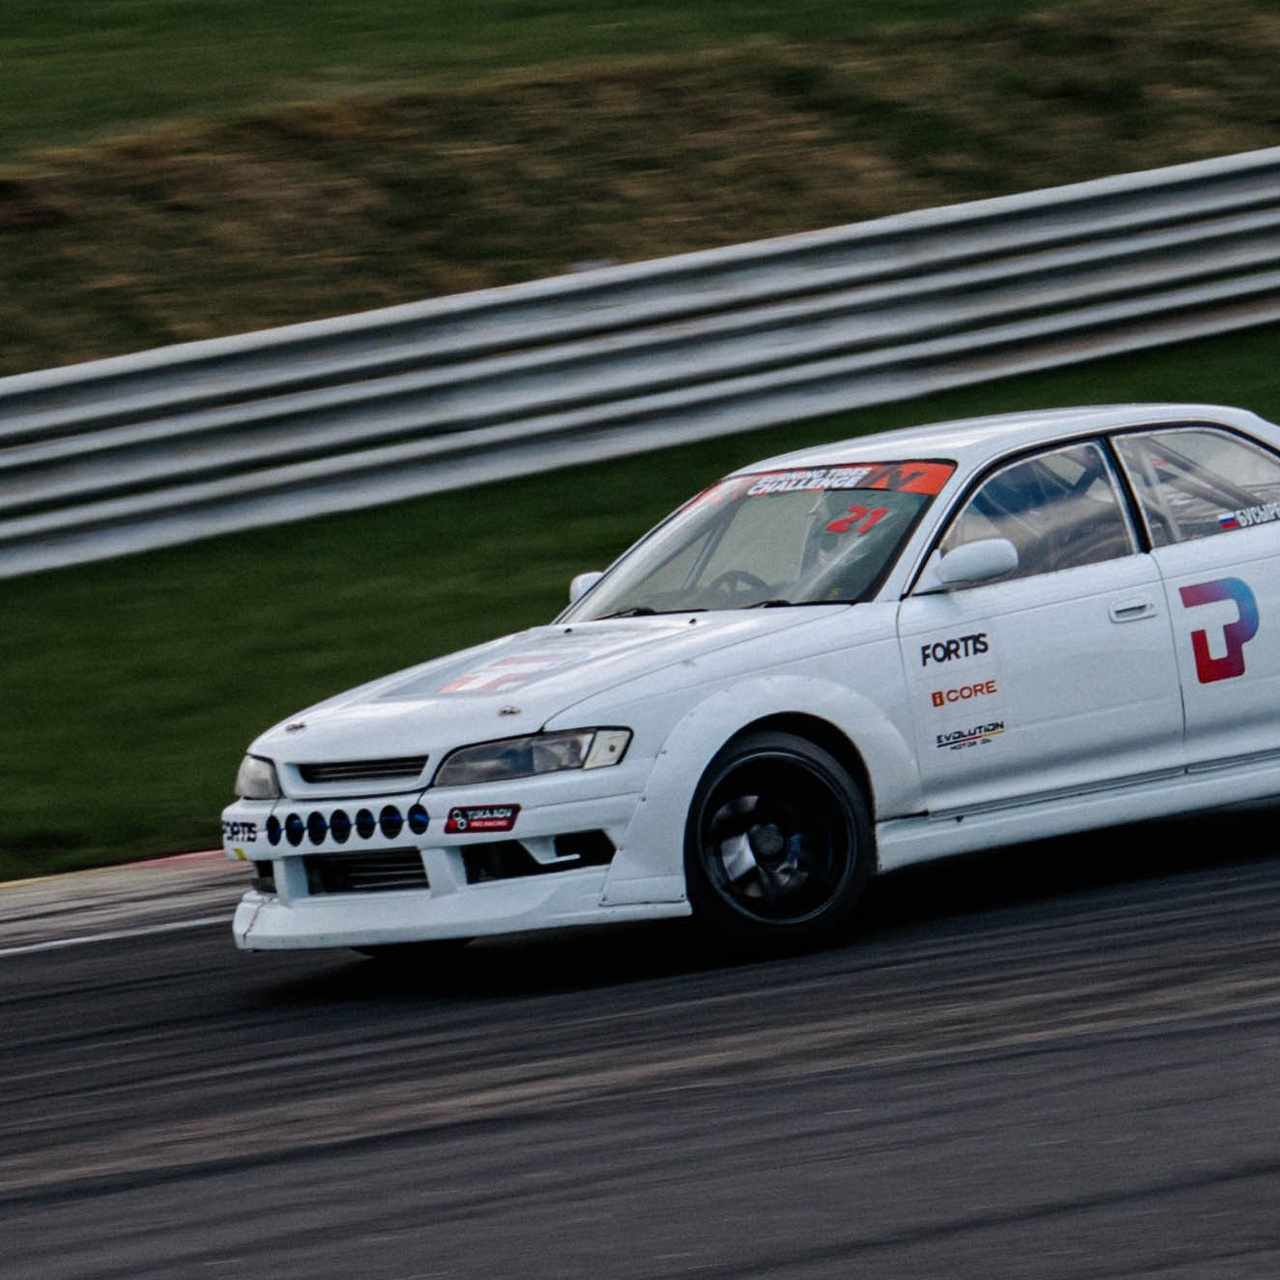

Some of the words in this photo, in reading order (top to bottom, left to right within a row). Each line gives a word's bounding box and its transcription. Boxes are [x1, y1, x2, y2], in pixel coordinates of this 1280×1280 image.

[747, 476, 862, 496] CHALLENGE
[826, 505, 889, 535] 21
[921, 632, 989, 667] FORTIS
[946, 680, 997, 702] CORE
[936, 721, 1004, 744] EVOLUTION
